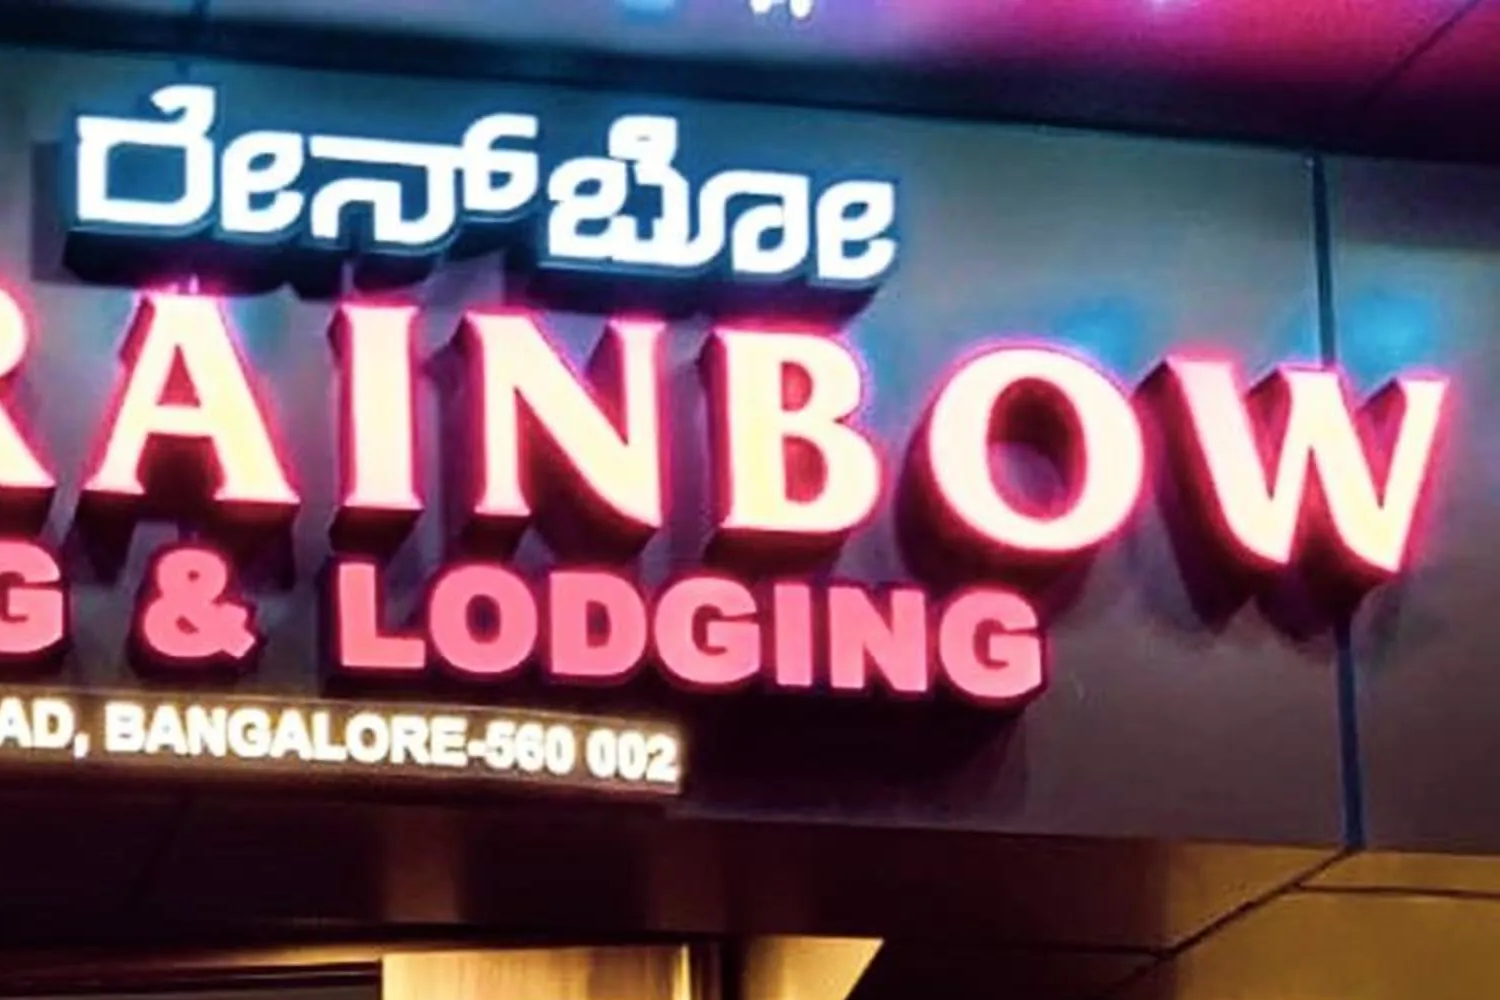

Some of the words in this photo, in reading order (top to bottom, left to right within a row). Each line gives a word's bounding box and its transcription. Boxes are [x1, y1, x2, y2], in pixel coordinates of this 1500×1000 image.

[142, 547, 254, 660] &
[337, 563, 1042, 698] LODGING
[104, 702, 573, 775] BANGALORE-560
[586, 729, 678, 782] 002
